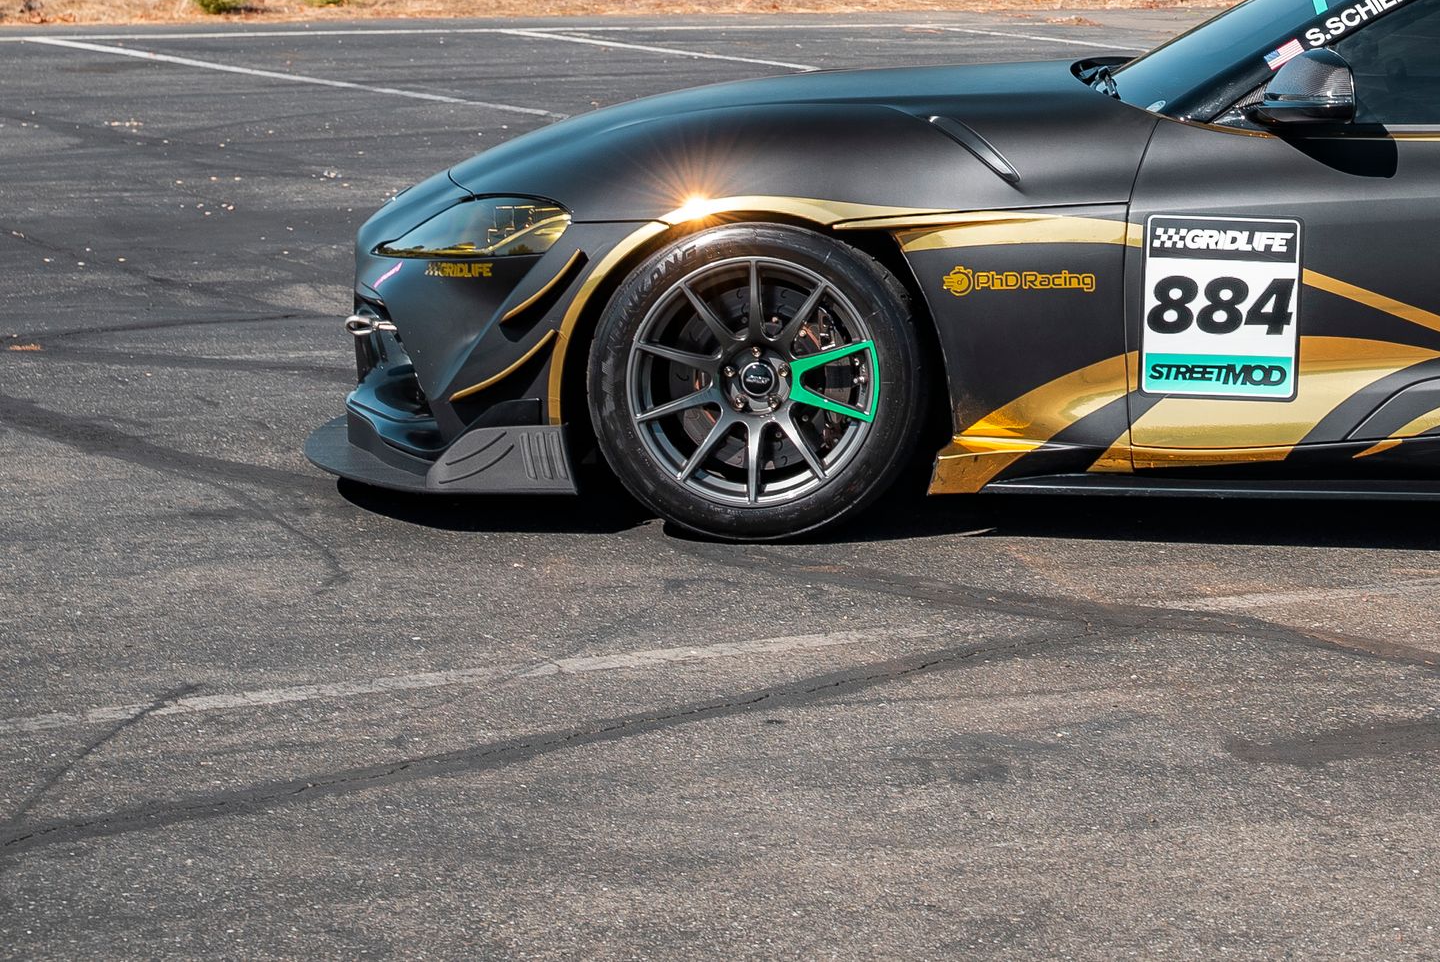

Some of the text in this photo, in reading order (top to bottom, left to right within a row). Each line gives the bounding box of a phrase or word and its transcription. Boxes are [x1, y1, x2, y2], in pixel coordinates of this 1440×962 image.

[1184, 229, 1295, 253] GRIDLIFE
[439, 262, 493, 277] GRIDLIFE
[975, 270, 1096, 292] PhD Racing
[1147, 275, 1296, 336] 884
